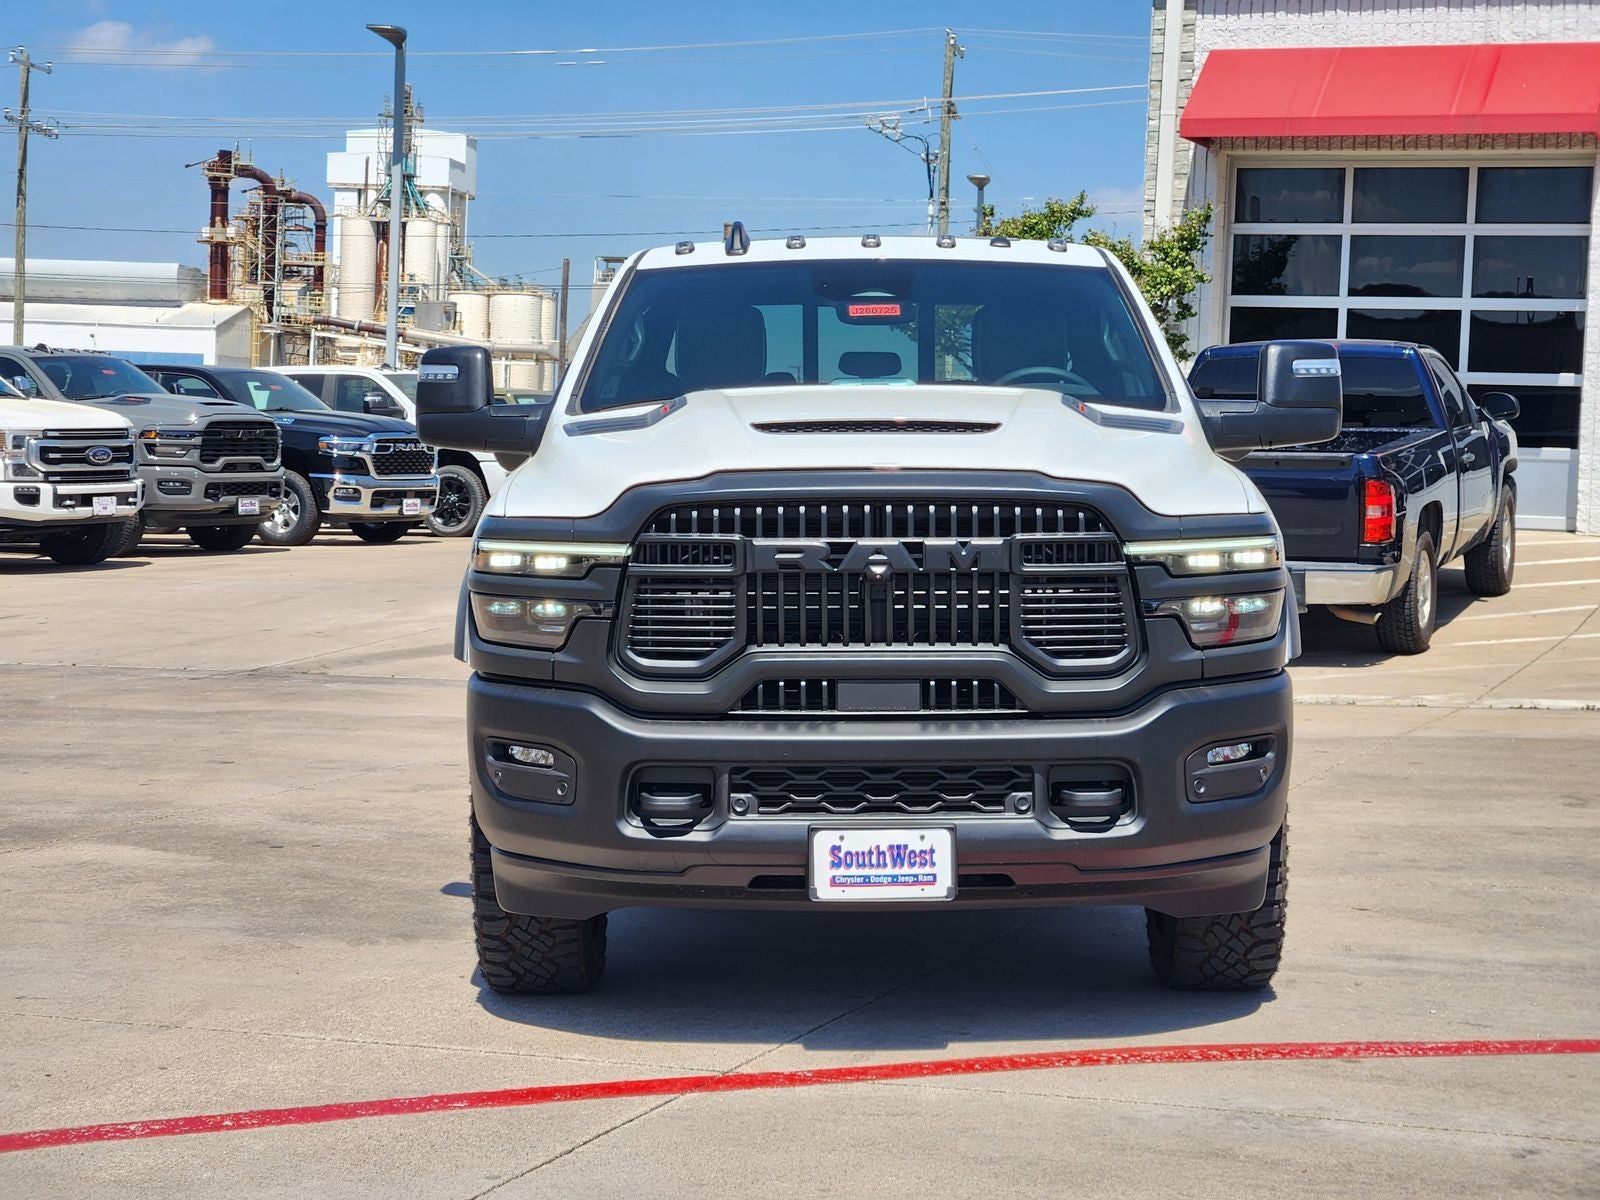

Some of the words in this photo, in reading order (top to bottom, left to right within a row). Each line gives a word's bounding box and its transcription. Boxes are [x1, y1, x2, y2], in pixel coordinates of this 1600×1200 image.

[748, 537, 1008, 572] RAM
[829, 844, 937, 870] SouthWest
[835, 875, 864, 885] Chrysler
[870, 874, 892, 884] Dodge
[897, 874, 913, 884] Jeep
[918, 873, 934, 882] Ram
